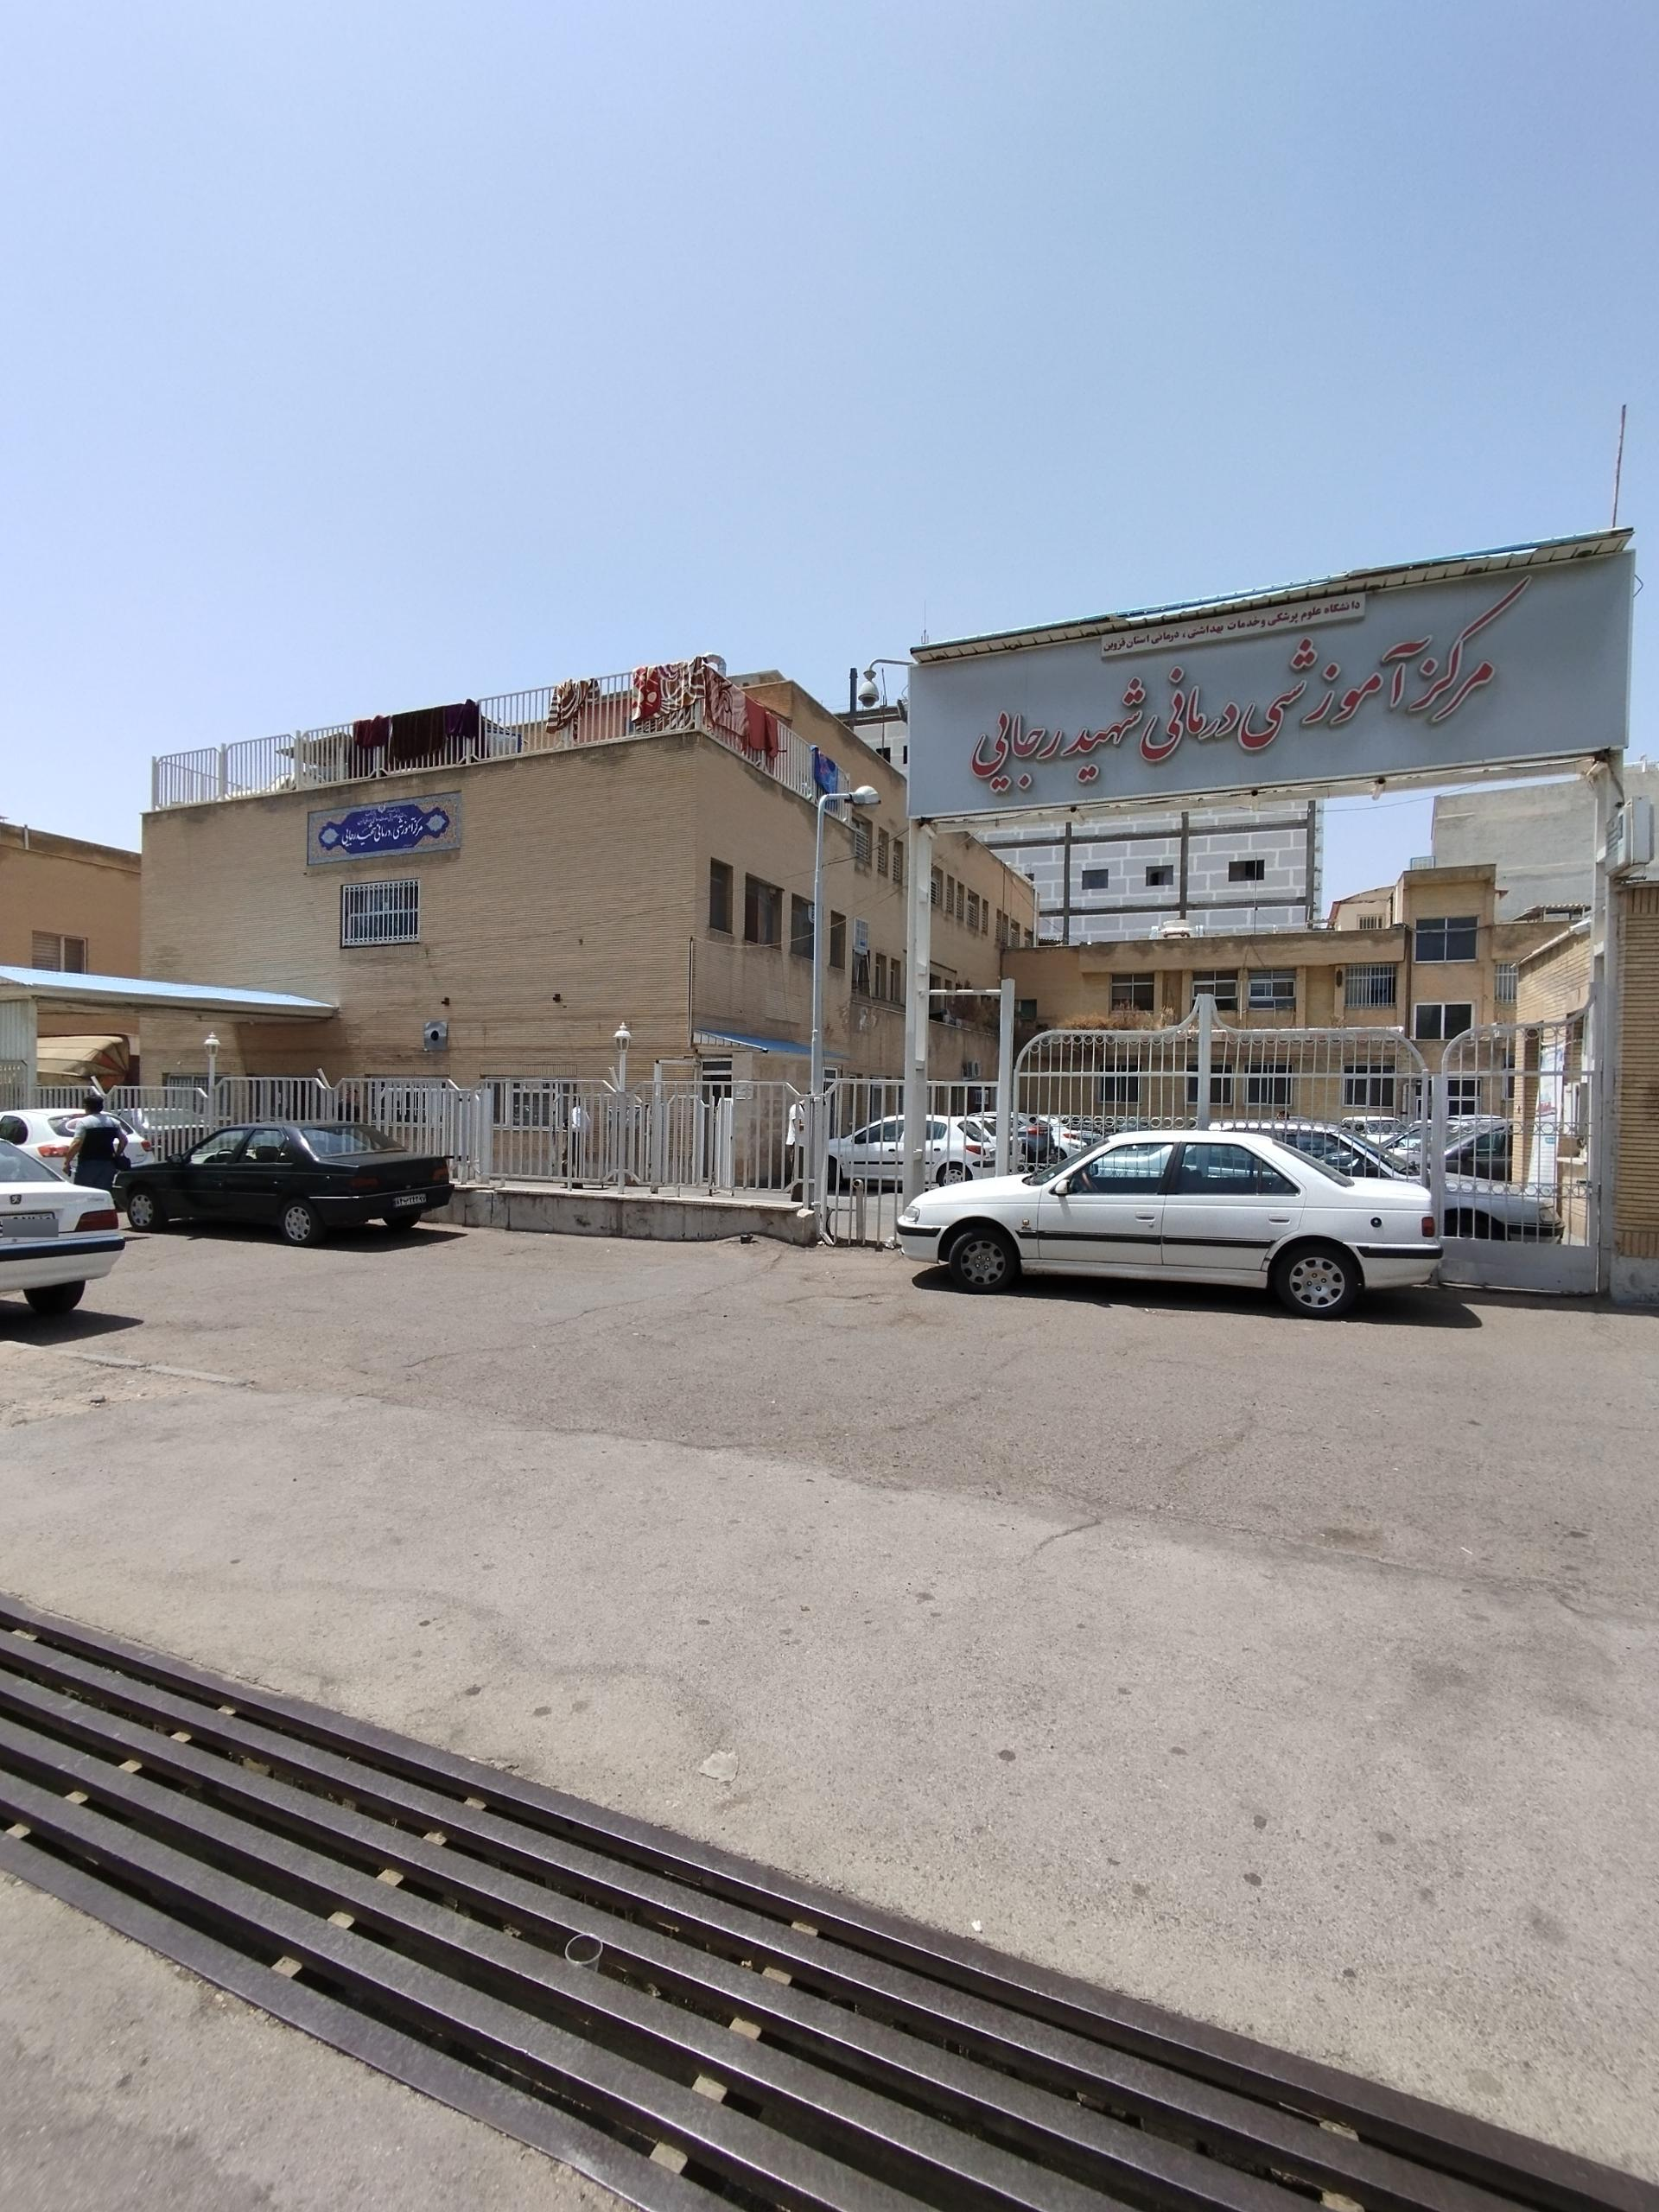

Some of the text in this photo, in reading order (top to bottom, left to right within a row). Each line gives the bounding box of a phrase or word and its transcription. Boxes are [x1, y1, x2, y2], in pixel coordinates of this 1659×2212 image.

[1300, 607, 1322, 620] علوم
[1324, 600, 1361, 614] دانشگاه
[1267, 612, 1299, 626] پزشکی
[1103, 637, 1126, 652] قزوین
[1126, 634, 1150, 649] استان
[1151, 631, 1179, 645] درمانی
[1409, 574, 1533, 724] مرکز
[1237, 635, 1433, 751] آموزشی
[1139, 665, 1241, 762] درمانی
[1060, 677, 1146, 783] شهید
[356, 822, 378, 846] شهید
[412, 817, 423, 837] مرکز
